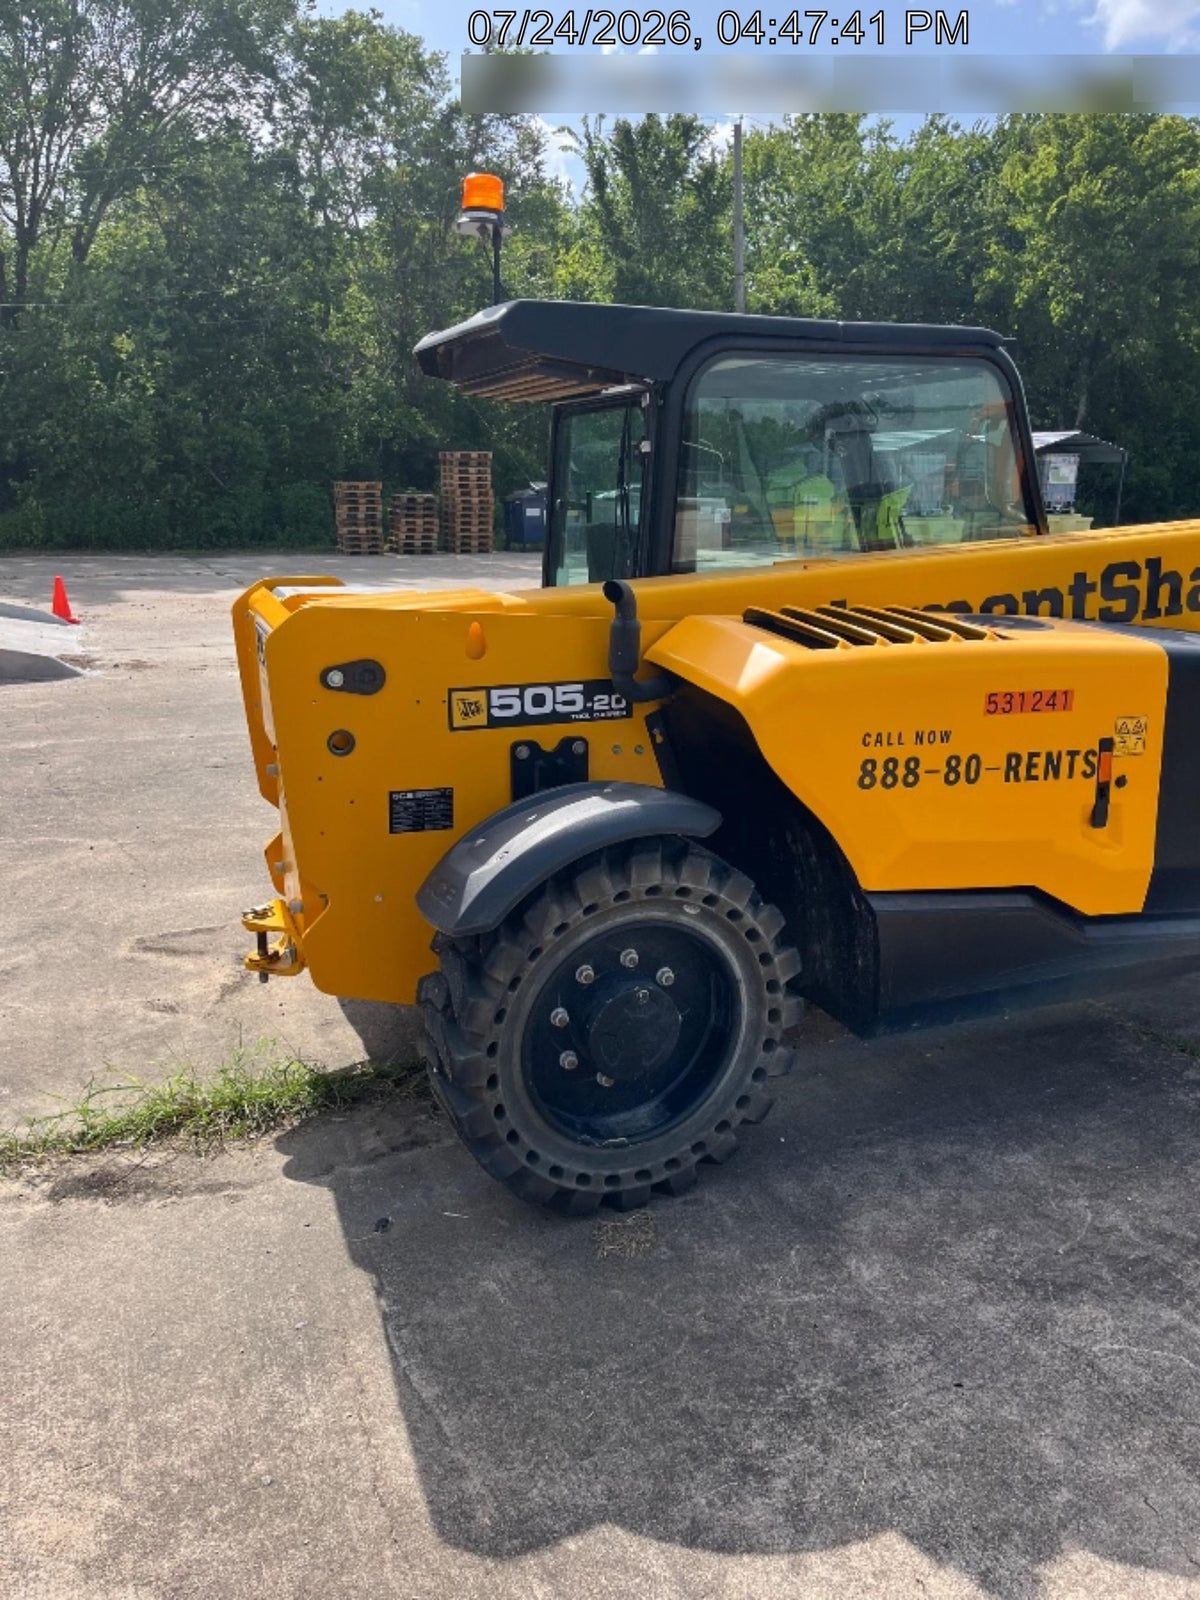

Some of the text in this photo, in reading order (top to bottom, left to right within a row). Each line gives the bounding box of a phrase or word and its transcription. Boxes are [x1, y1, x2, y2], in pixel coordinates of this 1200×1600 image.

[986, 691, 1070, 714] 531241
[862, 730, 952, 747] CALL NOW
[857, 748, 1097, 790] 888-80-RENTS
